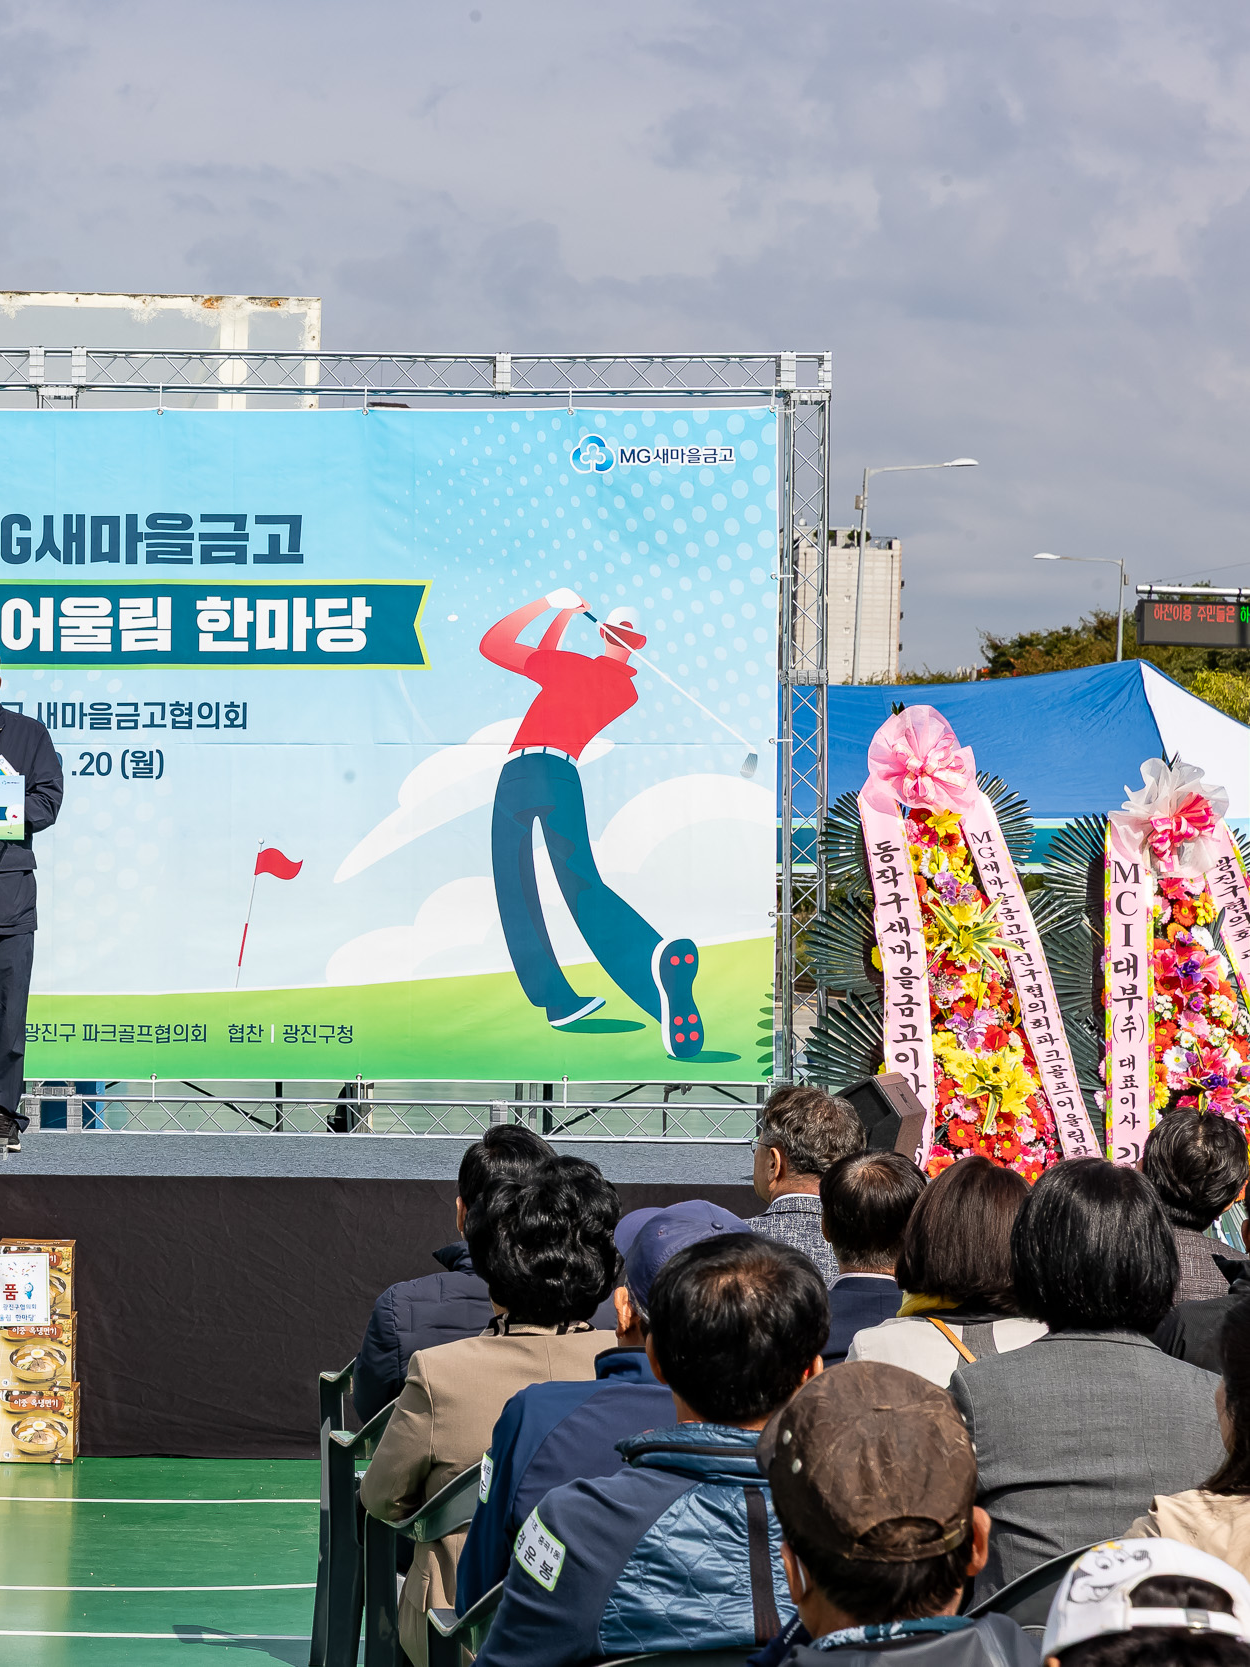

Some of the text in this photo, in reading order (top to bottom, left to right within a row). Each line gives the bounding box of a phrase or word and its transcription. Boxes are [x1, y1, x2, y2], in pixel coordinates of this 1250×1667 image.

[0, 596, 173, 652] 어울림
[196, 596, 372, 652] 한마당
[1153, 603, 1236, 623] 하천이용 주민들은
[36, 701, 249, 731] 새마을금고협의회
[121, 749, 165, 780] (월)
[25, 1022, 77, 1043] 광진구
[81, 1022, 208, 1044] 파크골프협의회
[227, 1023, 264, 1044] 협찬
[282, 1023, 354, 1045] 광진구청
[1118, 1054, 1141, 1130] 대표이사
[12, 1326, 26, 1335] 이중
[14, 1398, 27, 1408] 이중
